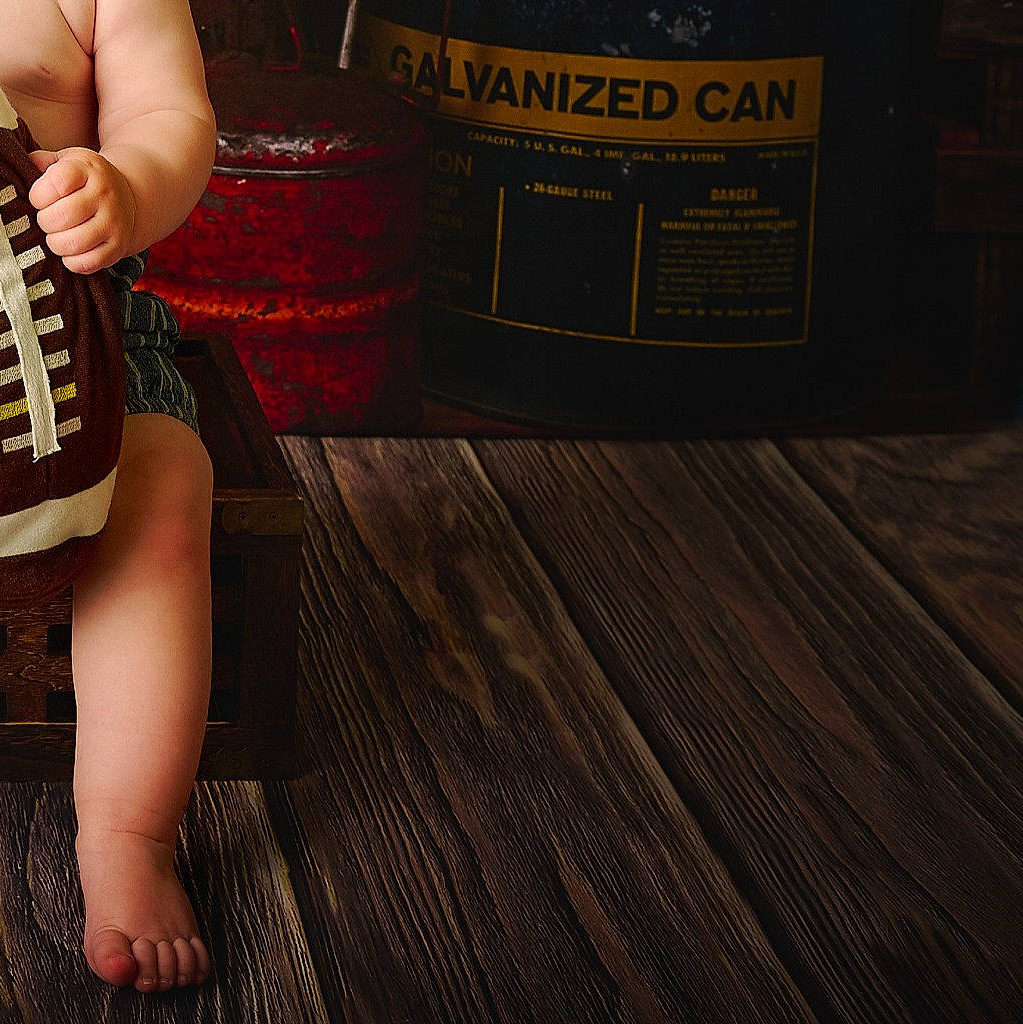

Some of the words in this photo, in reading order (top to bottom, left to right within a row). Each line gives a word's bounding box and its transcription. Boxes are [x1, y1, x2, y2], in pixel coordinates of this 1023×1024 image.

[390, 44, 678, 121] GALVANIZED
[694, 79, 797, 123] CAN
[710, 186, 759, 202] DANGER
